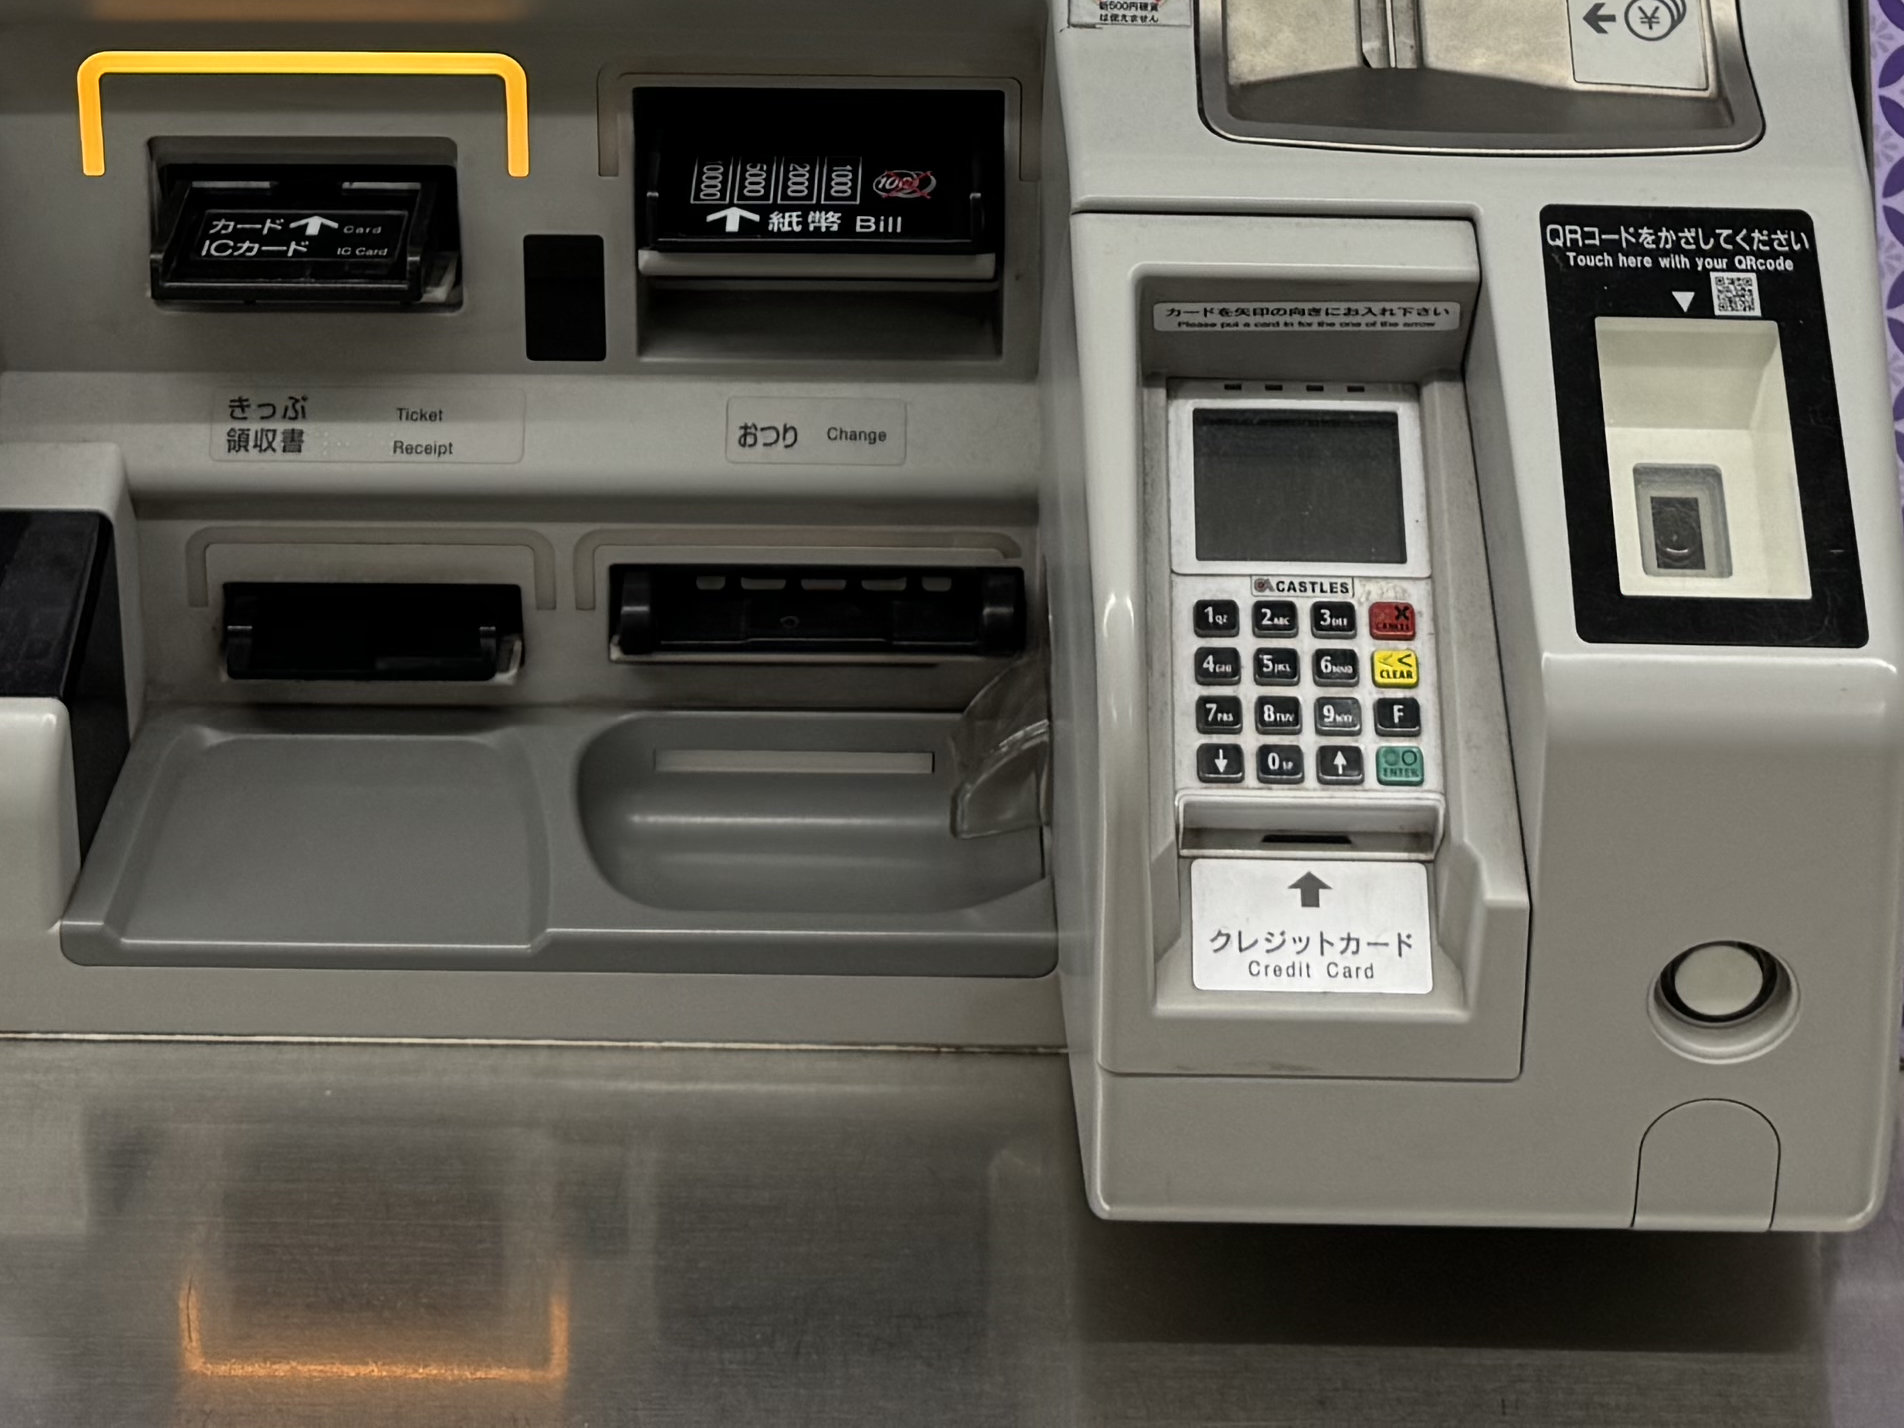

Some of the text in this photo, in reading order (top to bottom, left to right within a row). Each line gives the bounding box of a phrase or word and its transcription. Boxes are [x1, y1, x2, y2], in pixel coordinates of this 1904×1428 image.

[208, 218, 284, 235] カード
[343, 225, 382, 234] Card
[768, 211, 842, 232] 紙幣
[855, 216, 902, 233] Bill
[1546, 224, 1810, 251] QRコードをかざしてください
[201, 240, 309, 257] ICカード
[355, 247, 388, 256] Card
[1566, 252, 1794, 272] Touch here with your QRcode
[228, 396, 308, 421] きっぷ
[397, 407, 443, 422] Ticket
[226, 428, 304, 454] 領収書
[737, 422, 800, 451] おつり
[826, 425, 887, 446] Change
[393, 440, 453, 457] Receipt
[1276, 581, 1350, 594] CASTLES
[1204, 606, 1213, 624] 1
[1261, 608, 1273, 625] 2
[1379, 669, 1413, 680] CLEAR
[1392, 705, 1404, 723] F
[1209, 928, 1414, 959] クレジットカード
[1248, 959, 1375, 981] Credit Card
